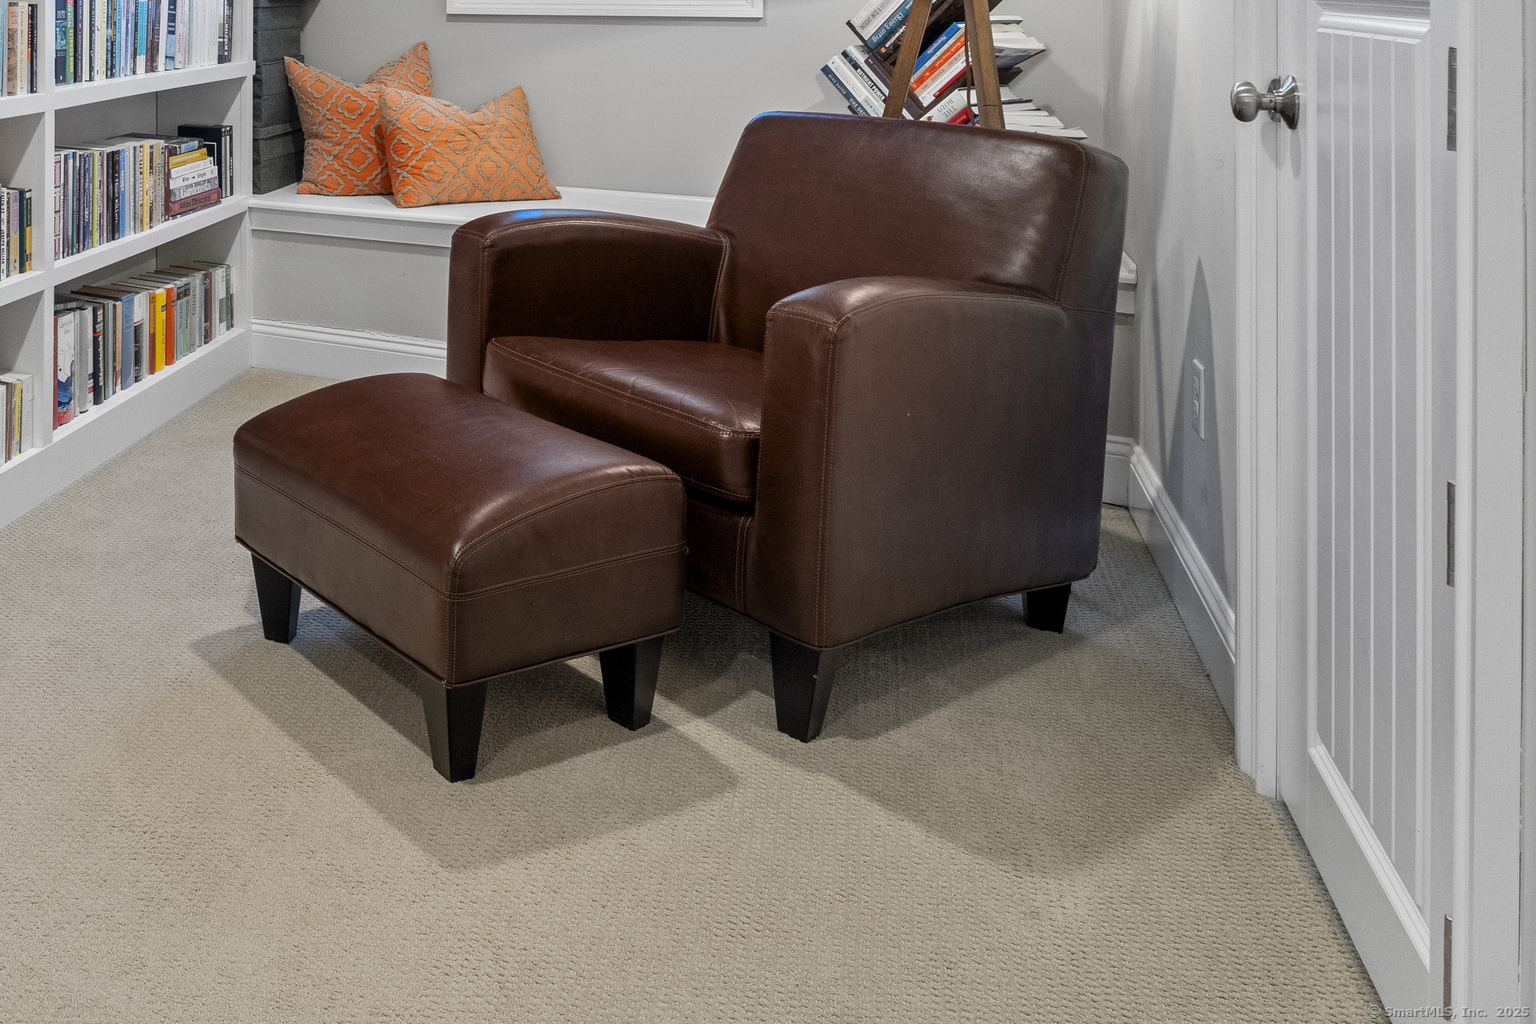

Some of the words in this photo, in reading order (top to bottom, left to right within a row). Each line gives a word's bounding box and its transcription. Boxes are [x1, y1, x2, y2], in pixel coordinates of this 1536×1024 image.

[872, 28, 886, 42] Brain
[886, 12, 904, 30] Energy
[942, 106, 957, 119] THE
[181, 182, 210, 196] Gardenista
